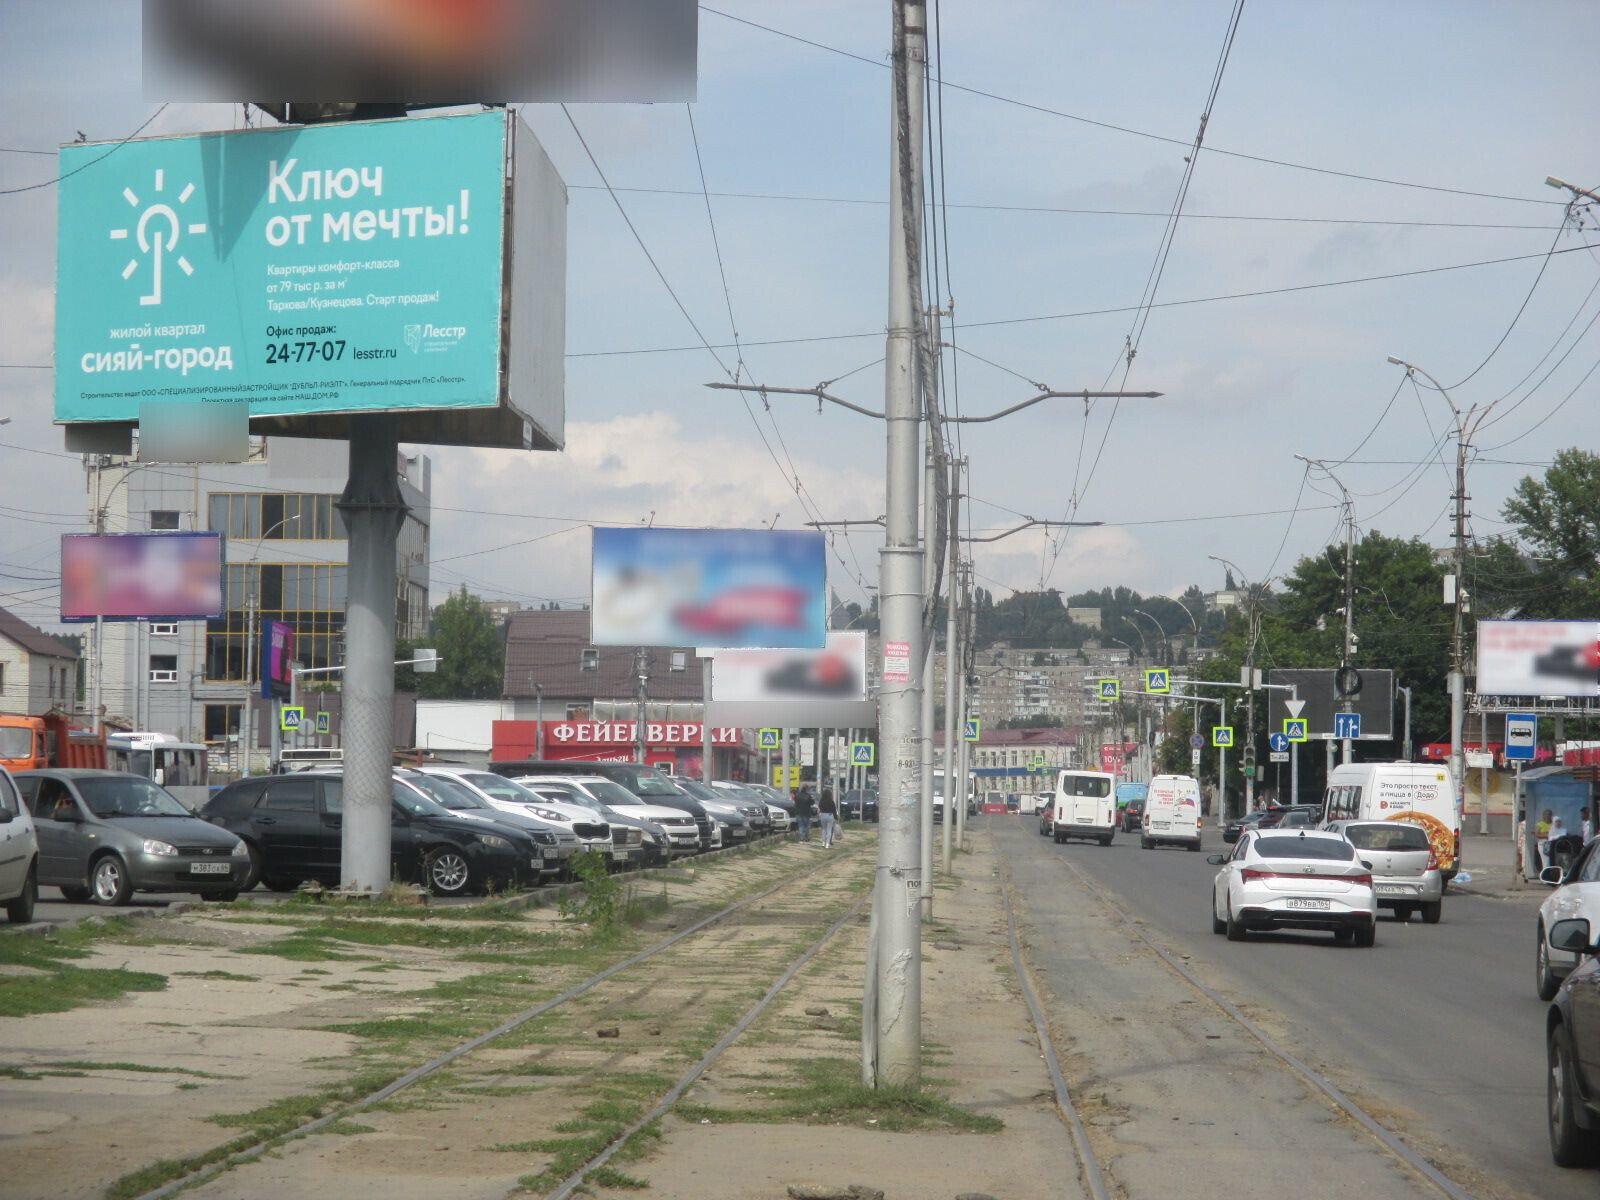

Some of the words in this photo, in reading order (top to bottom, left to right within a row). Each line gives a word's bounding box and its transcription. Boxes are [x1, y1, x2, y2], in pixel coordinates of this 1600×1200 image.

[268, 158, 383, 204] Ключ
[265, 214, 312, 247] от
[322, 189, 470, 243] мечты!
[266, 264, 316, 277] Квартиры
[317, 258, 400, 275] комфорт-класса
[266, 285, 278, 293] от
[279, 281, 292, 292] 79
[313, 282, 323, 293] р.
[324, 281, 336, 290] за
[366, 293, 397, 309] Старт
[398, 290, 440, 307] продаж!
[110, 322, 152, 339] жилой
[154, 323, 206, 339] квартал
[266, 325, 294, 339] Офис
[296, 325, 337, 338] продаж:
[422, 323, 466, 340] Лесстр
[81, 343, 234, 376] сияй-город
[265, 340, 346, 364] 24-77-07
[353, 347, 397, 361] lesstr.ru
[141, 389, 157, 397] ООО
[1416, 791, 1435, 799] Додо
